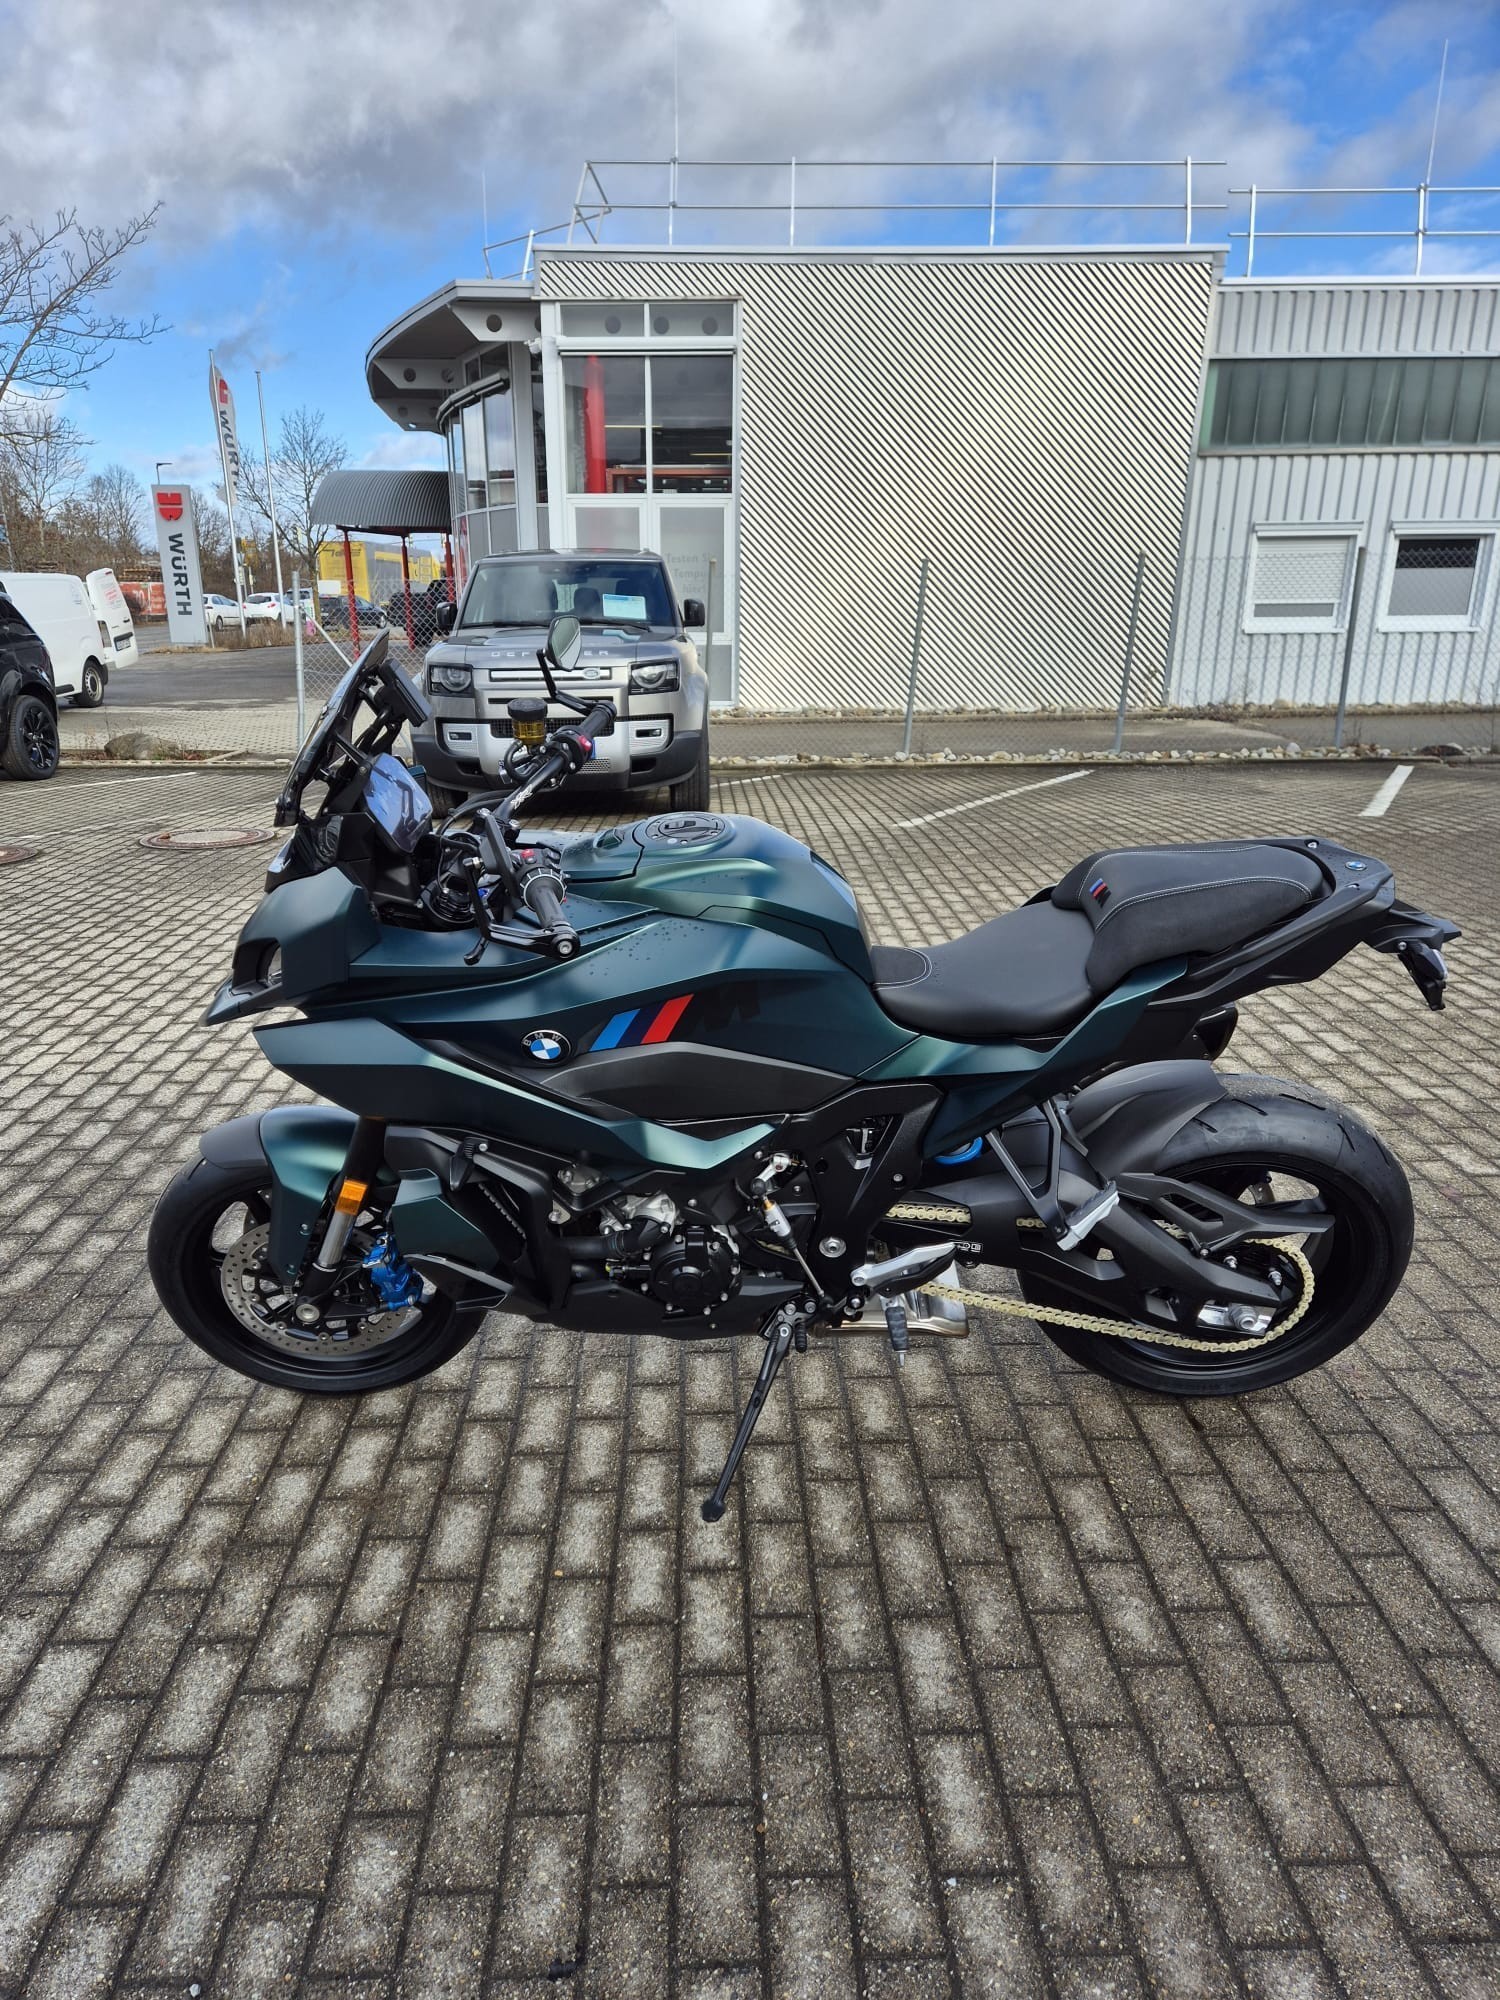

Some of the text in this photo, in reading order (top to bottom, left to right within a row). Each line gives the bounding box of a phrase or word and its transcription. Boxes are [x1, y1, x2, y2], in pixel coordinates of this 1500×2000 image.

[168, 532, 193, 616] WÜRTH
[490, 649, 609, 658] DEFER
[520, 1032, 562, 1047] BMW
